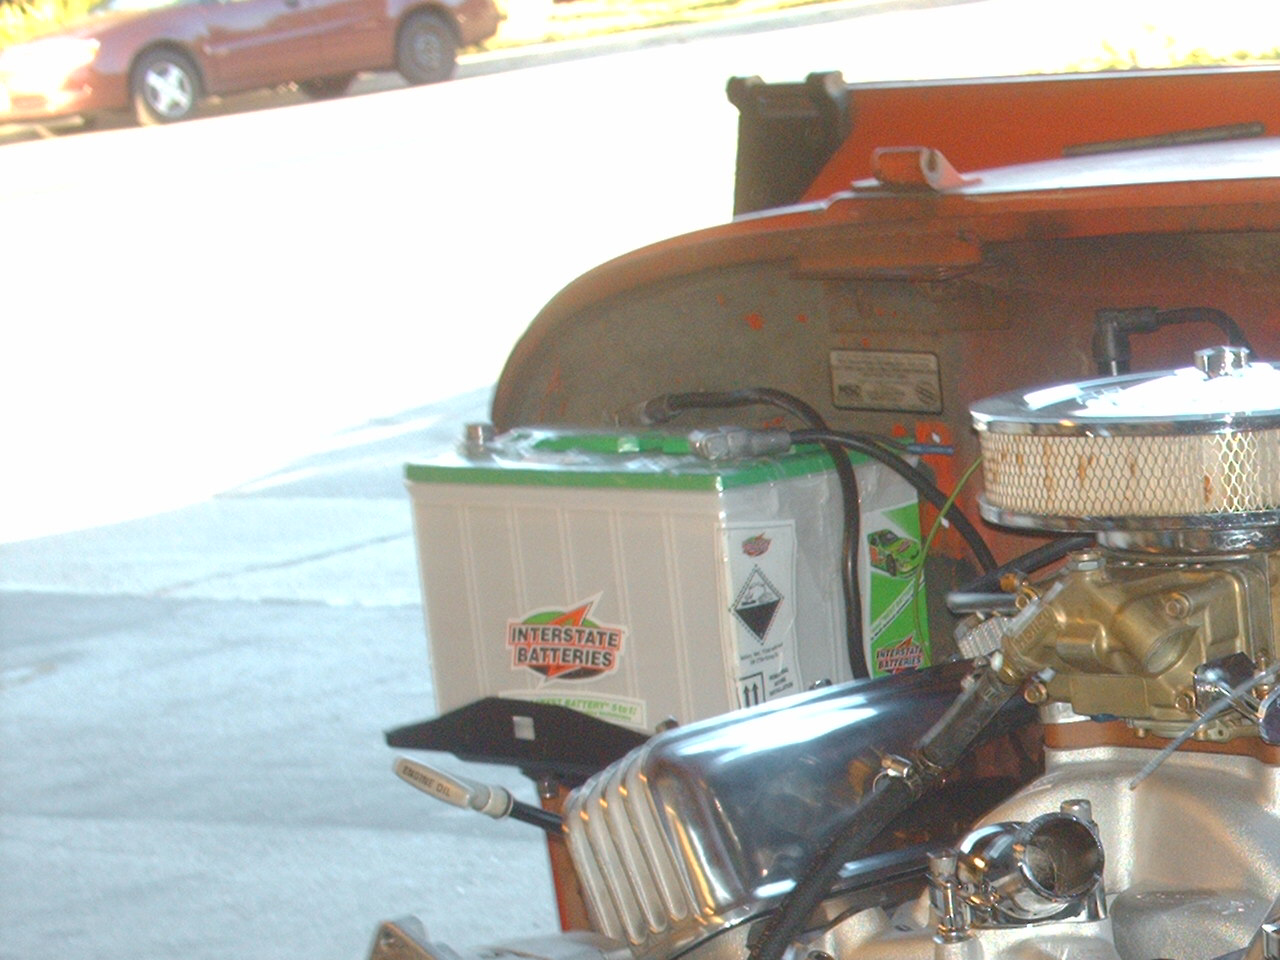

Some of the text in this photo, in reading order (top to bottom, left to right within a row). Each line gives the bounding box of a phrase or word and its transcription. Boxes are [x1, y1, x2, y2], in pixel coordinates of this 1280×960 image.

[511, 627, 619, 647] INTERSTATE
[517, 647, 613, 667] BATTERIES
[402, 765, 451, 797] ENGINE OIL
